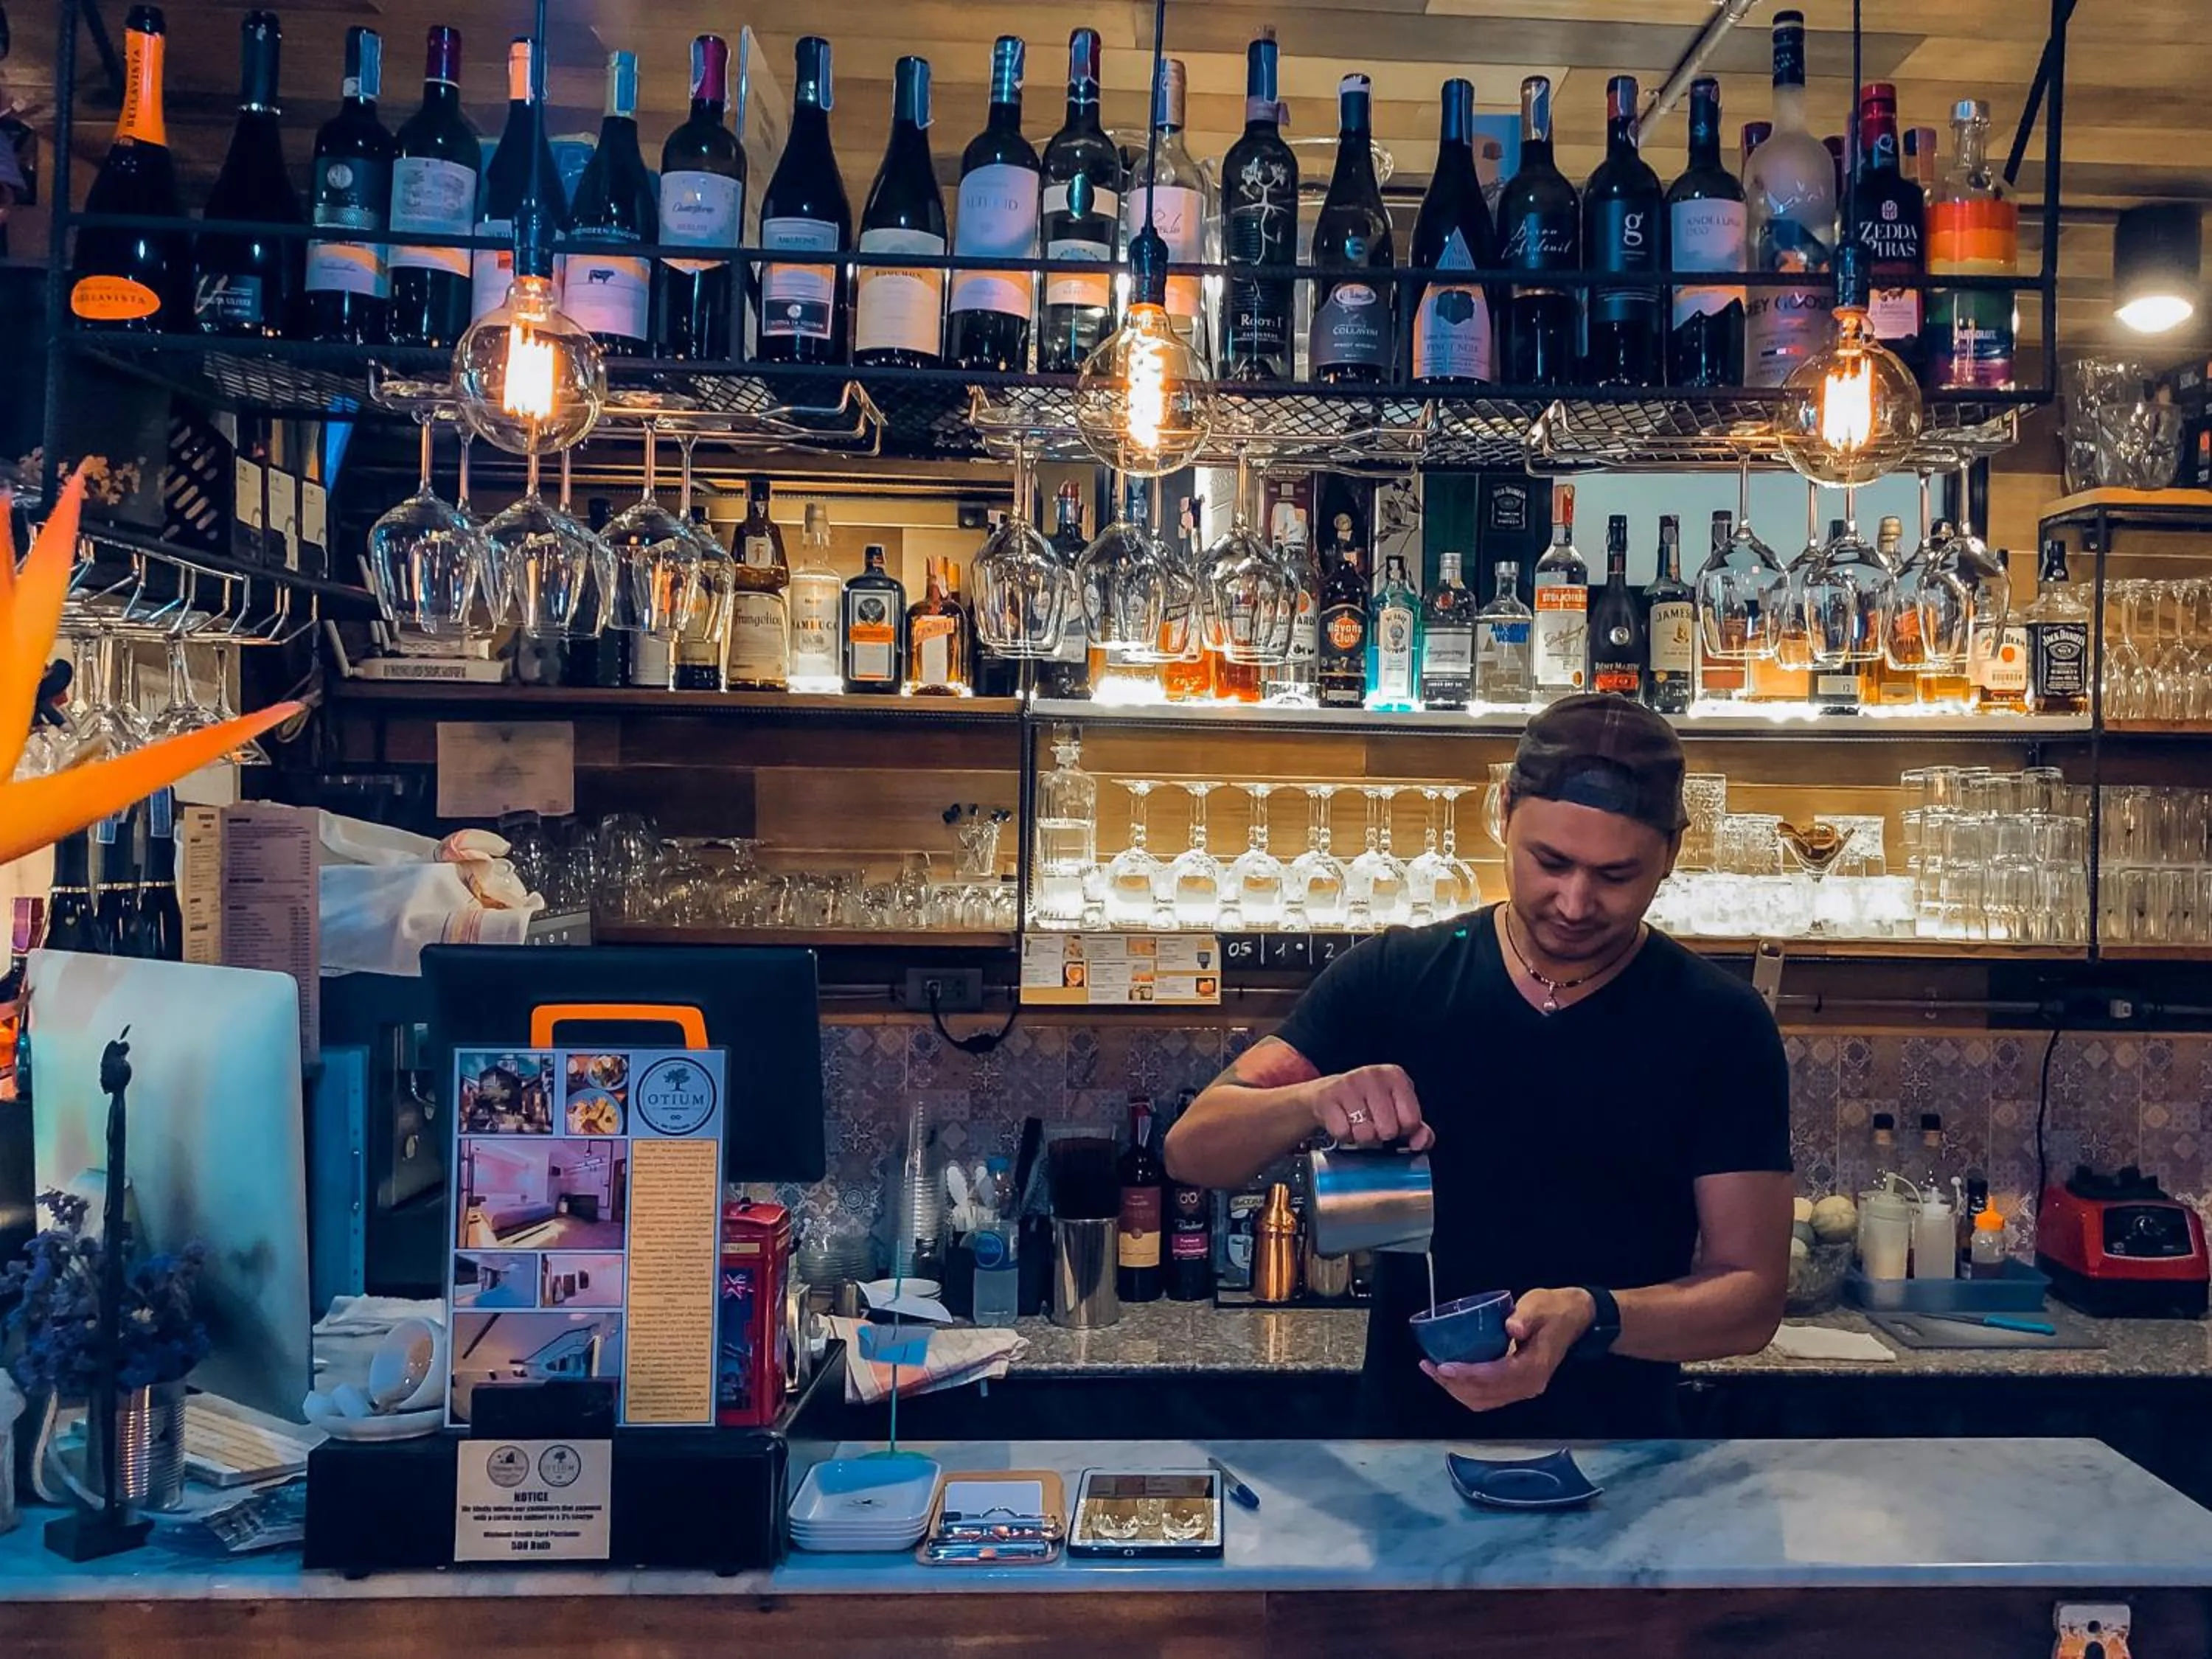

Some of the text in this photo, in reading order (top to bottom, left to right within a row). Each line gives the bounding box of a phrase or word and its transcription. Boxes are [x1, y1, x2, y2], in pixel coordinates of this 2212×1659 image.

[1623, 212, 1644, 246] g
[1333, 633, 1356, 644] Club
[648, 1093, 704, 1105] OTIUM
[515, 1492, 549, 1502] NOTICE
